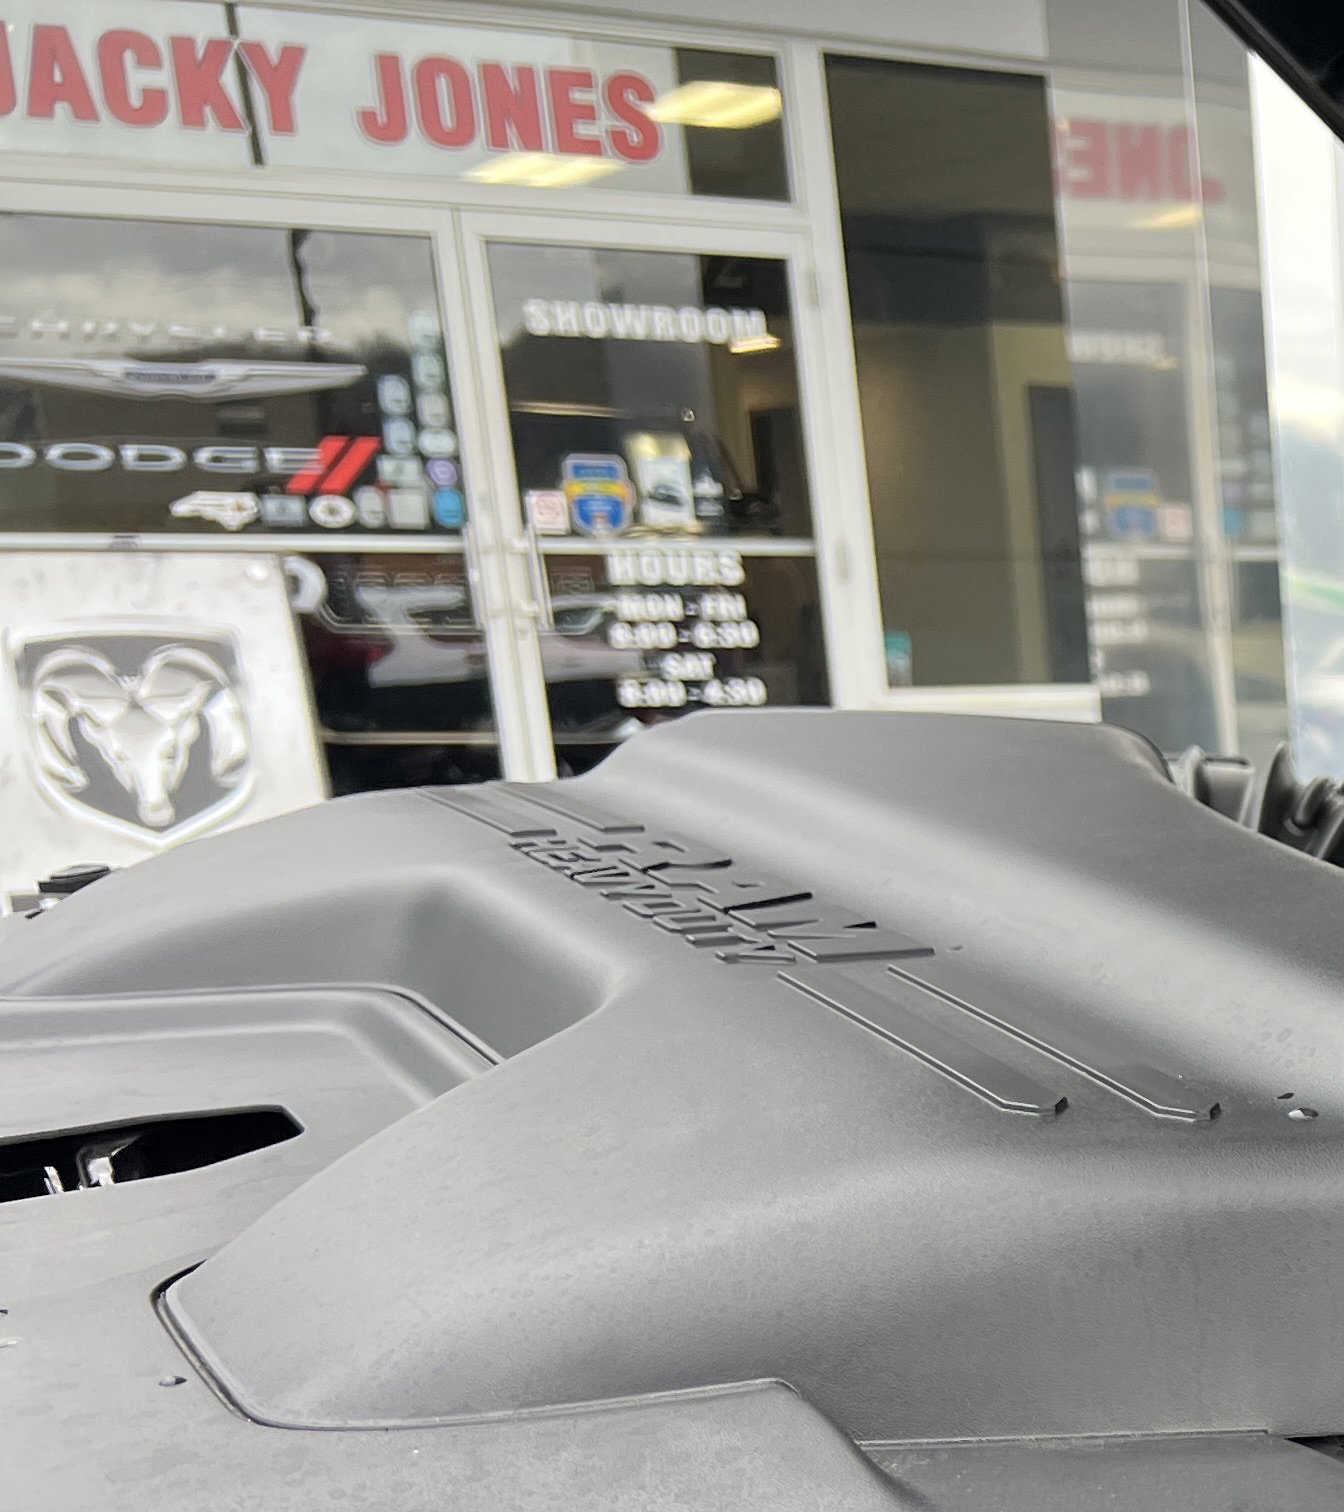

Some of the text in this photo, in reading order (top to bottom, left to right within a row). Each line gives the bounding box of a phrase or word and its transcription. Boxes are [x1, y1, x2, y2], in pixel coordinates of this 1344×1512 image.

[357, 52, 664, 162] JONES
[522, 299, 768, 345] SHOWROOM
[607, 550, 745, 586] HOURS
